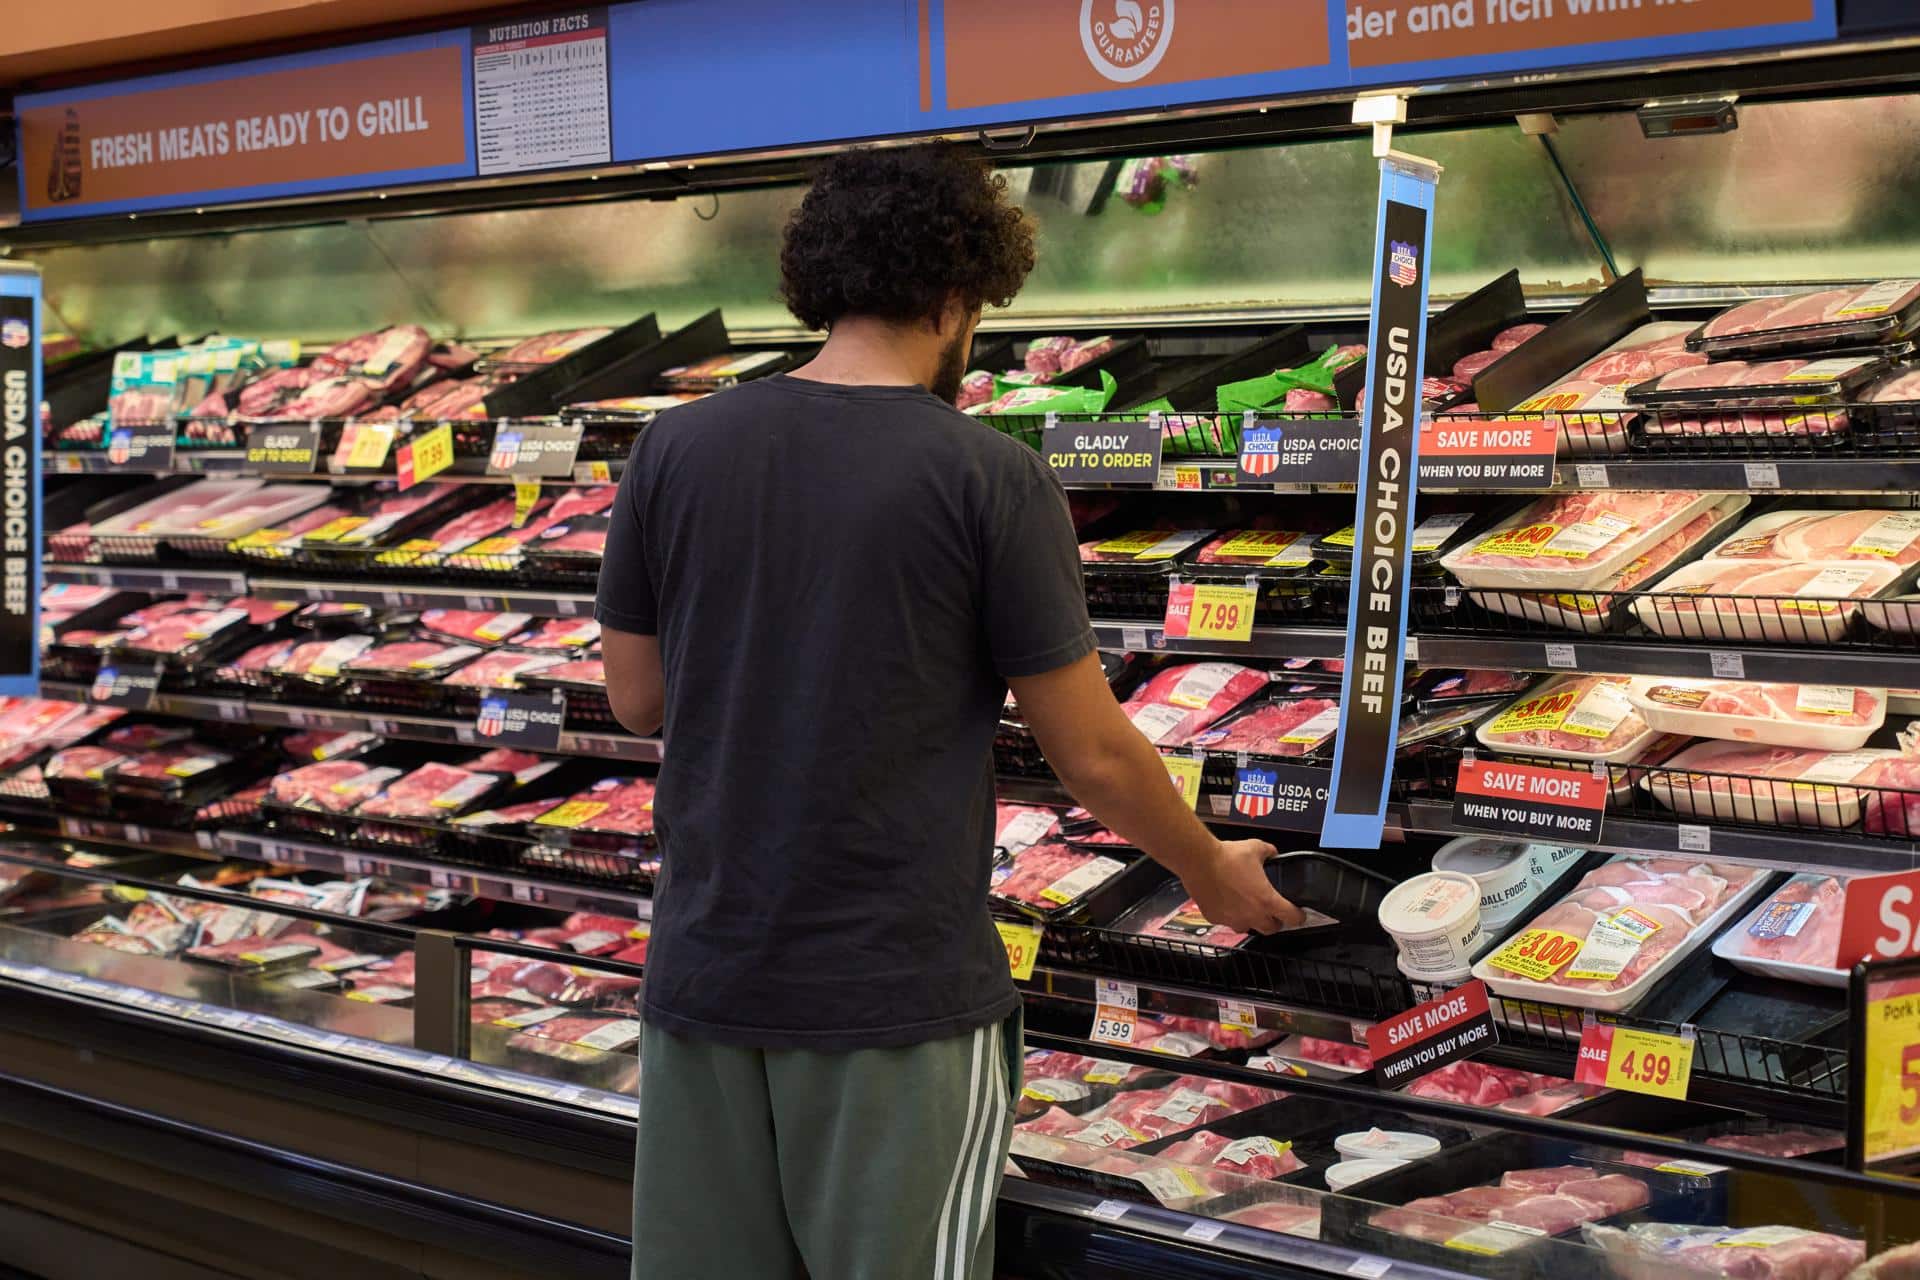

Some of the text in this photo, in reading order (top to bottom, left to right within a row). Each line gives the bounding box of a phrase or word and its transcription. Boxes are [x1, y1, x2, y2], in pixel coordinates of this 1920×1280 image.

[489, 14, 589, 42] NUTRITION FACTS
[1407, 0, 1474, 33] and
[1094, 5, 1160, 63] GUARANTEED
[90, 96, 429, 169] FRESH MEATS READY TO GRILL
[4, 369, 27, 441] USDA
[1074, 435, 1129, 450] GLADLY
[1248, 443, 1275, 451] CHOICE
[1283, 438, 1363, 451] USDA CHOIC
[1436, 430, 1533, 448] SAVE MORE
[1049, 453, 1153, 468] CUT TO ORDER
[1282, 453, 1313, 465] BEEF
[1419, 464, 1545, 478] WHEN YOU BUY MORE
[5, 445, 27, 552] CHOICE
[1360, 326, 1409, 714] USDA CHOICE BEEF
[5, 557, 27, 615] BEEF
[1168, 604, 1190, 616] SALE
[1199, 603, 1239, 630] 7.99
[1242, 783, 1271, 793] CHOICE
[1278, 784, 1312, 798] USDA
[1482, 771, 1582, 799] SAVE MORE
[1277, 800, 1309, 812] BEEF
[1463, 803, 1593, 832] WHEN YOU BUY MORE
[1480, 892, 1505, 906] DALL
[1504, 878, 1528, 899] FOODS
[1519, 932, 1578, 966] 3.00
[1388, 996, 1468, 1045] SAVE MORE
[1883, 1000, 1913, 1021] Pork
[1098, 1019, 1131, 1038] 5.99
[1383, 1023, 1489, 1079] WHEN YOU BUY MORE
[1580, 1046, 1608, 1062] SALE
[1620, 1050, 1671, 1085] 4.99
